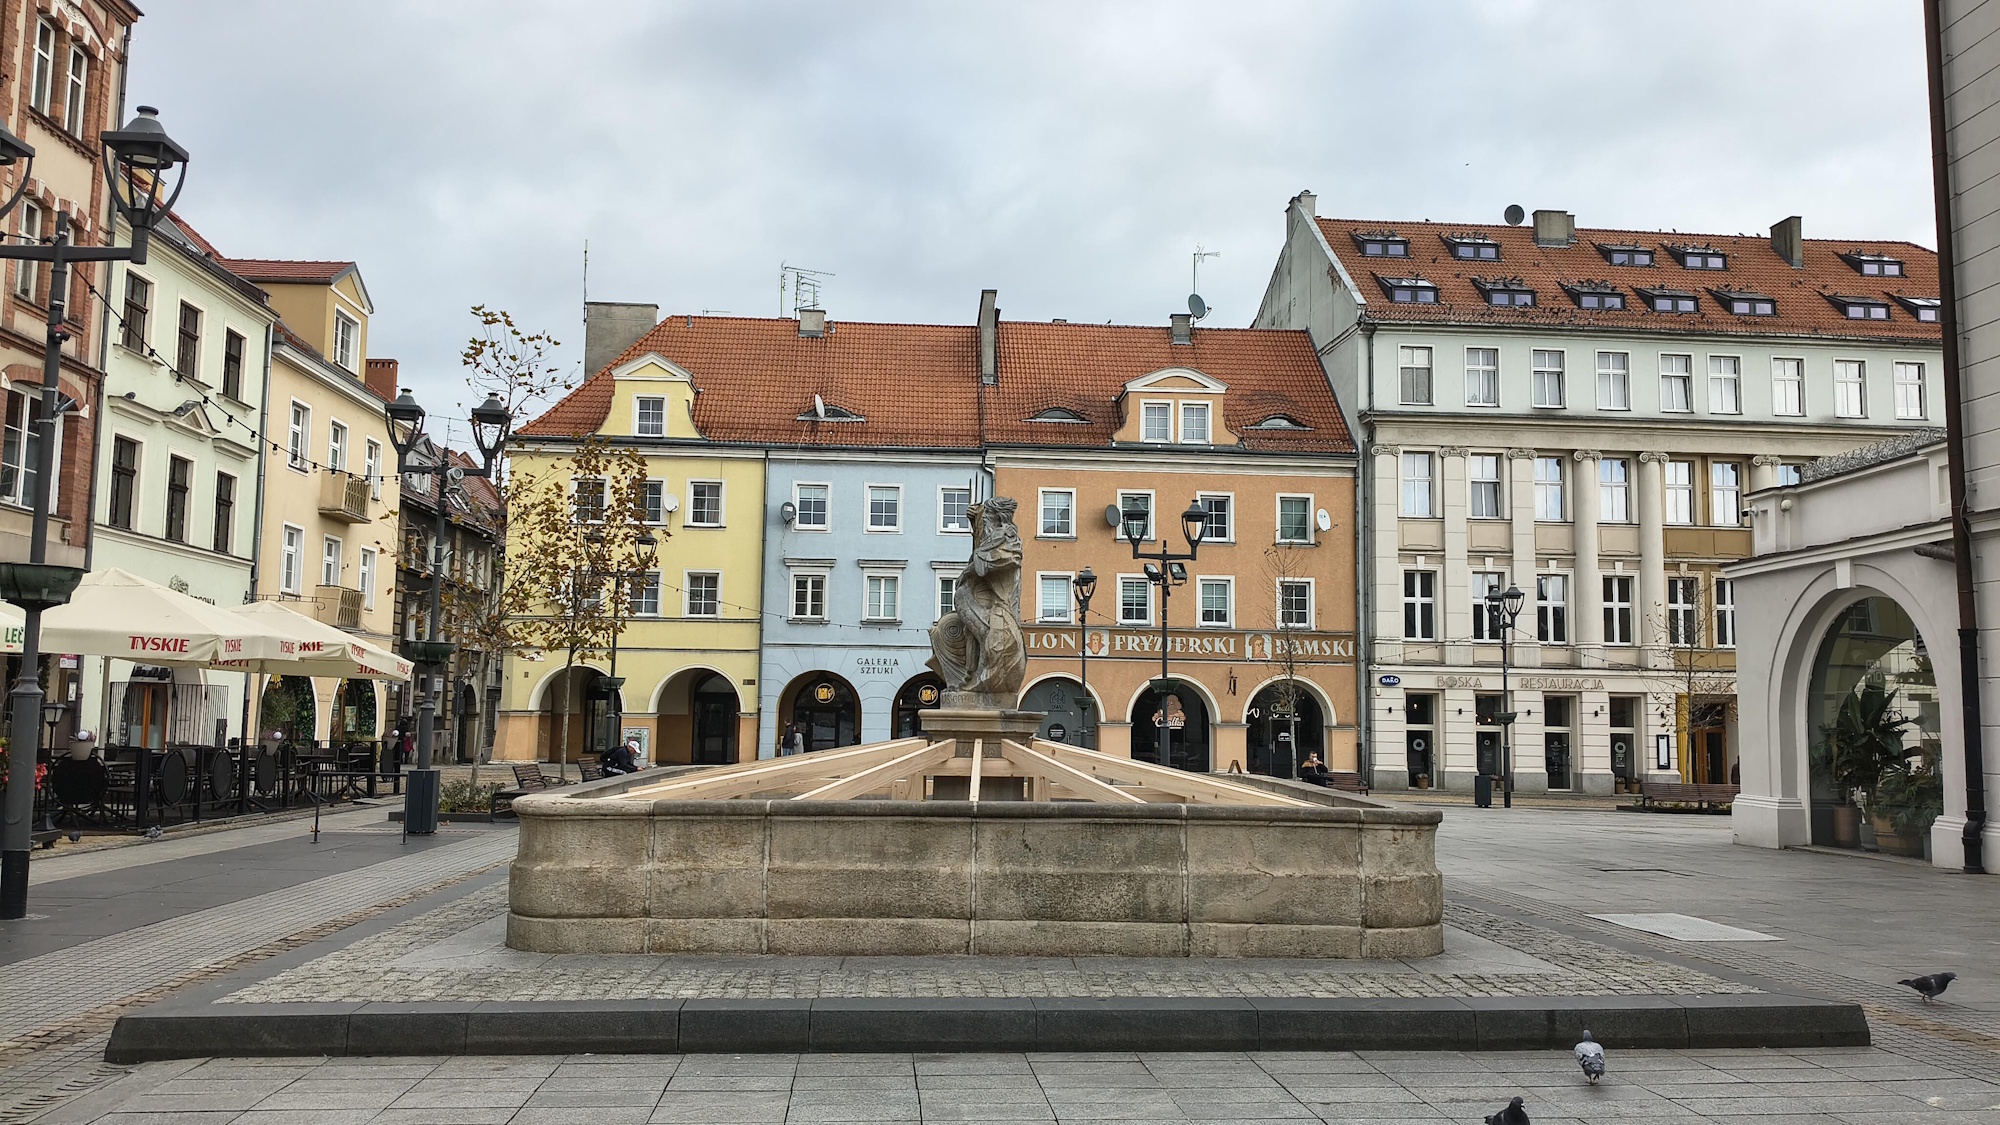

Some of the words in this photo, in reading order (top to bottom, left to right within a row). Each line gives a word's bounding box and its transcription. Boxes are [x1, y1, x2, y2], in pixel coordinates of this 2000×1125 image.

[5, 627, 23, 643] LEC
[129, 636, 190, 653] TYSKIE
[225, 638, 242, 653] TYSKIE
[280, 640, 295, 655] TYSKIE
[298, 641, 324, 652] SKIE
[351, 643, 366, 659] TYSKIE
[1028, 632, 1076, 649] LON
[1275, 639, 1354, 657] DAMSKI
[857, 658, 899, 666] GALERIA
[1437, 676, 1482, 688] BOSKA
[1520, 678, 1604, 690] RESTAURACJA
